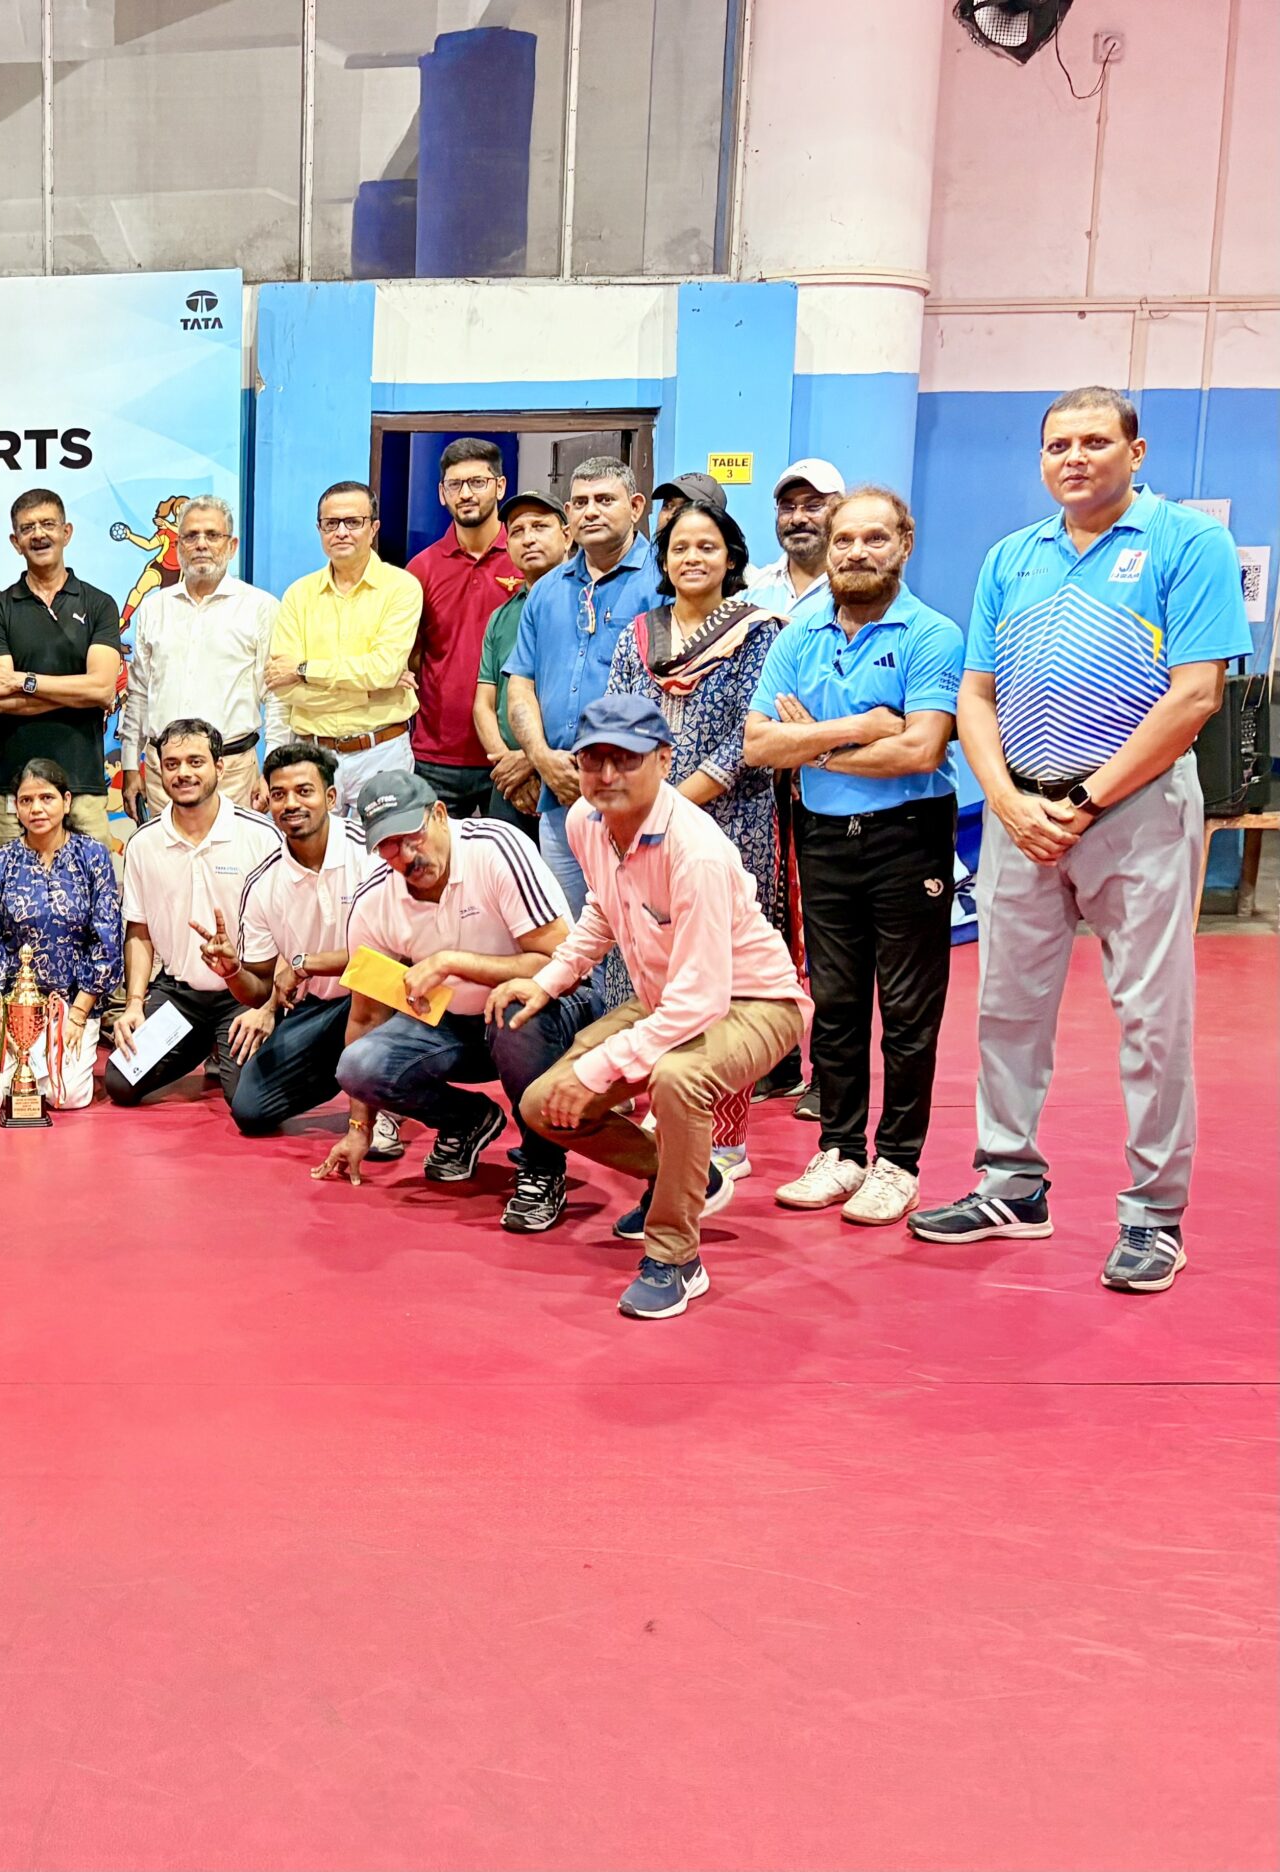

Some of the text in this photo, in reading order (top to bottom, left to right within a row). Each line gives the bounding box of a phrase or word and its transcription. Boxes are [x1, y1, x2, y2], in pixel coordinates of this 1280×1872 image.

[180, 317, 223, 330] TATA
[712, 457, 749, 467] TABLE
[726, 469, 733, 479] 3
